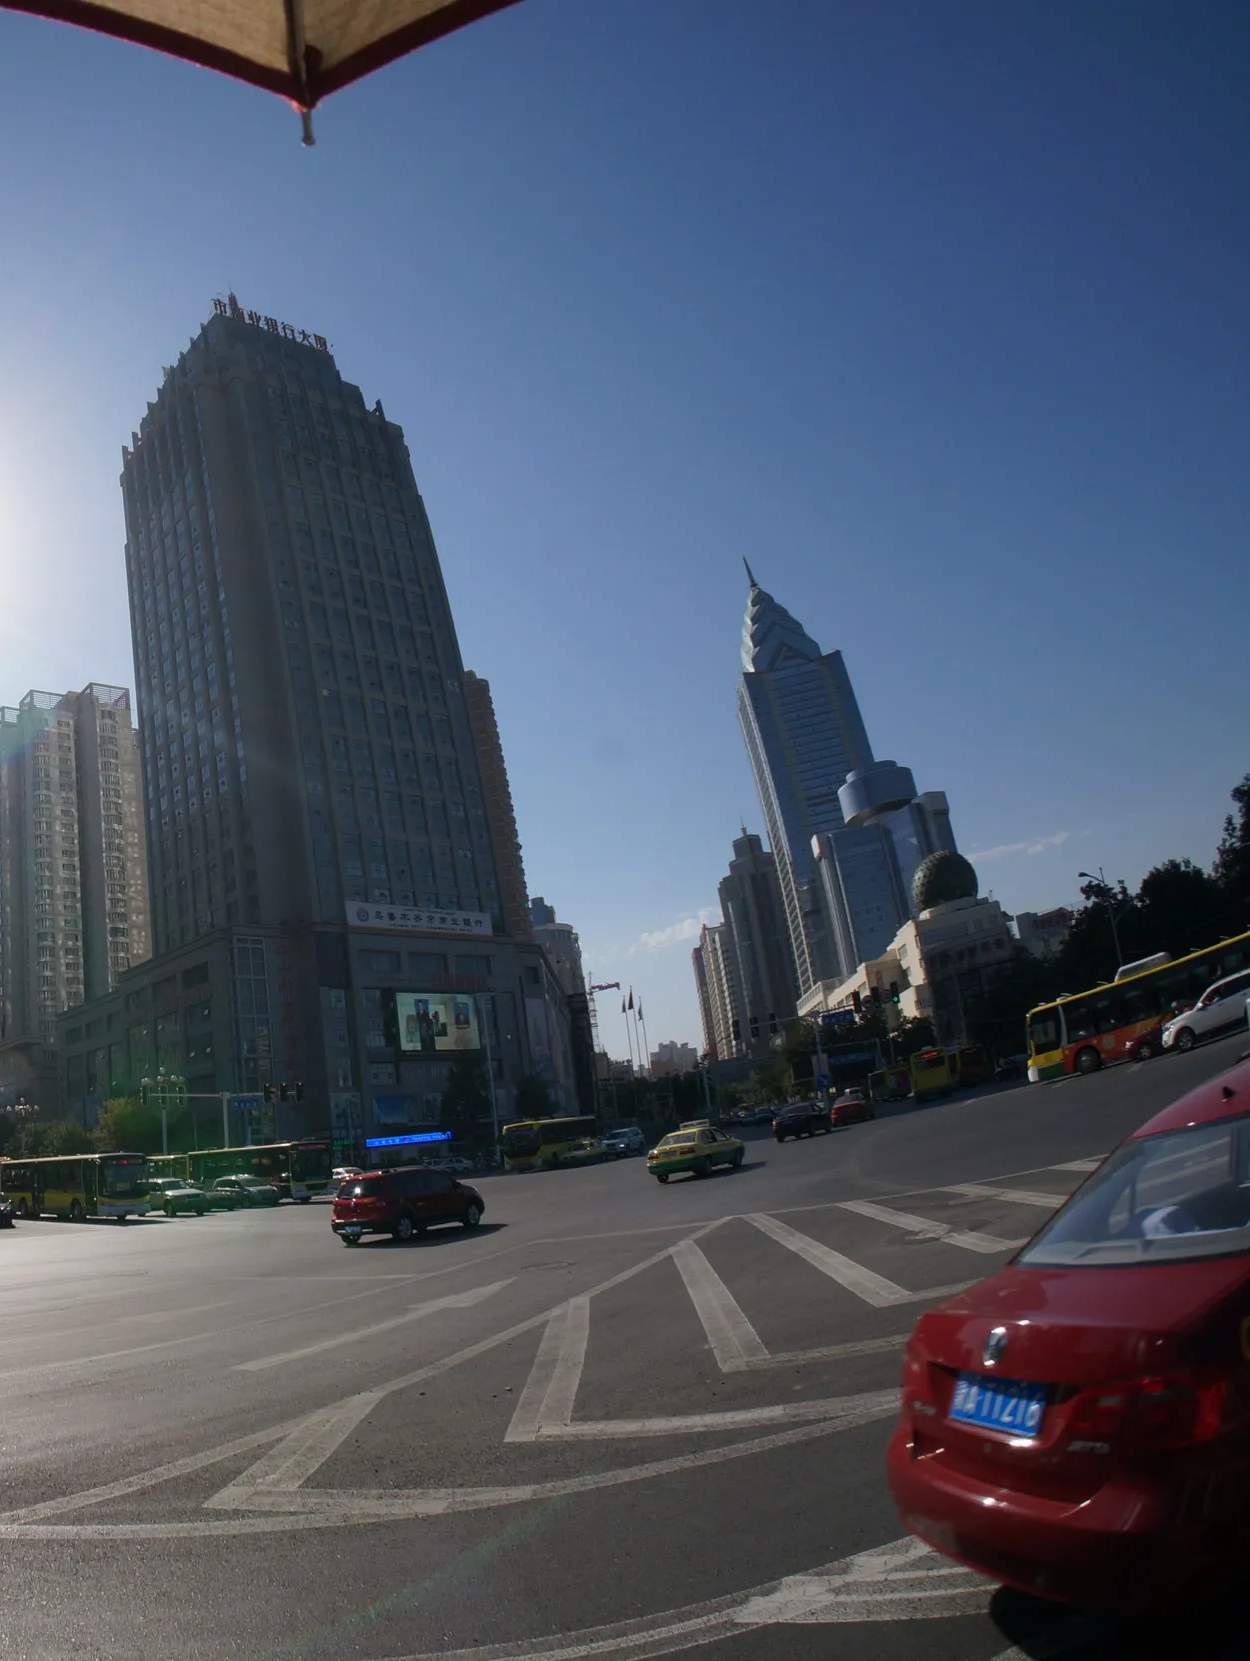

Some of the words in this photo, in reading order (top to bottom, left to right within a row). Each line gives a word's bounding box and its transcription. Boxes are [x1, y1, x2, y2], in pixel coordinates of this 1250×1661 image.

[374, 910, 483, 928] 乌鲁木齐市商业银行
